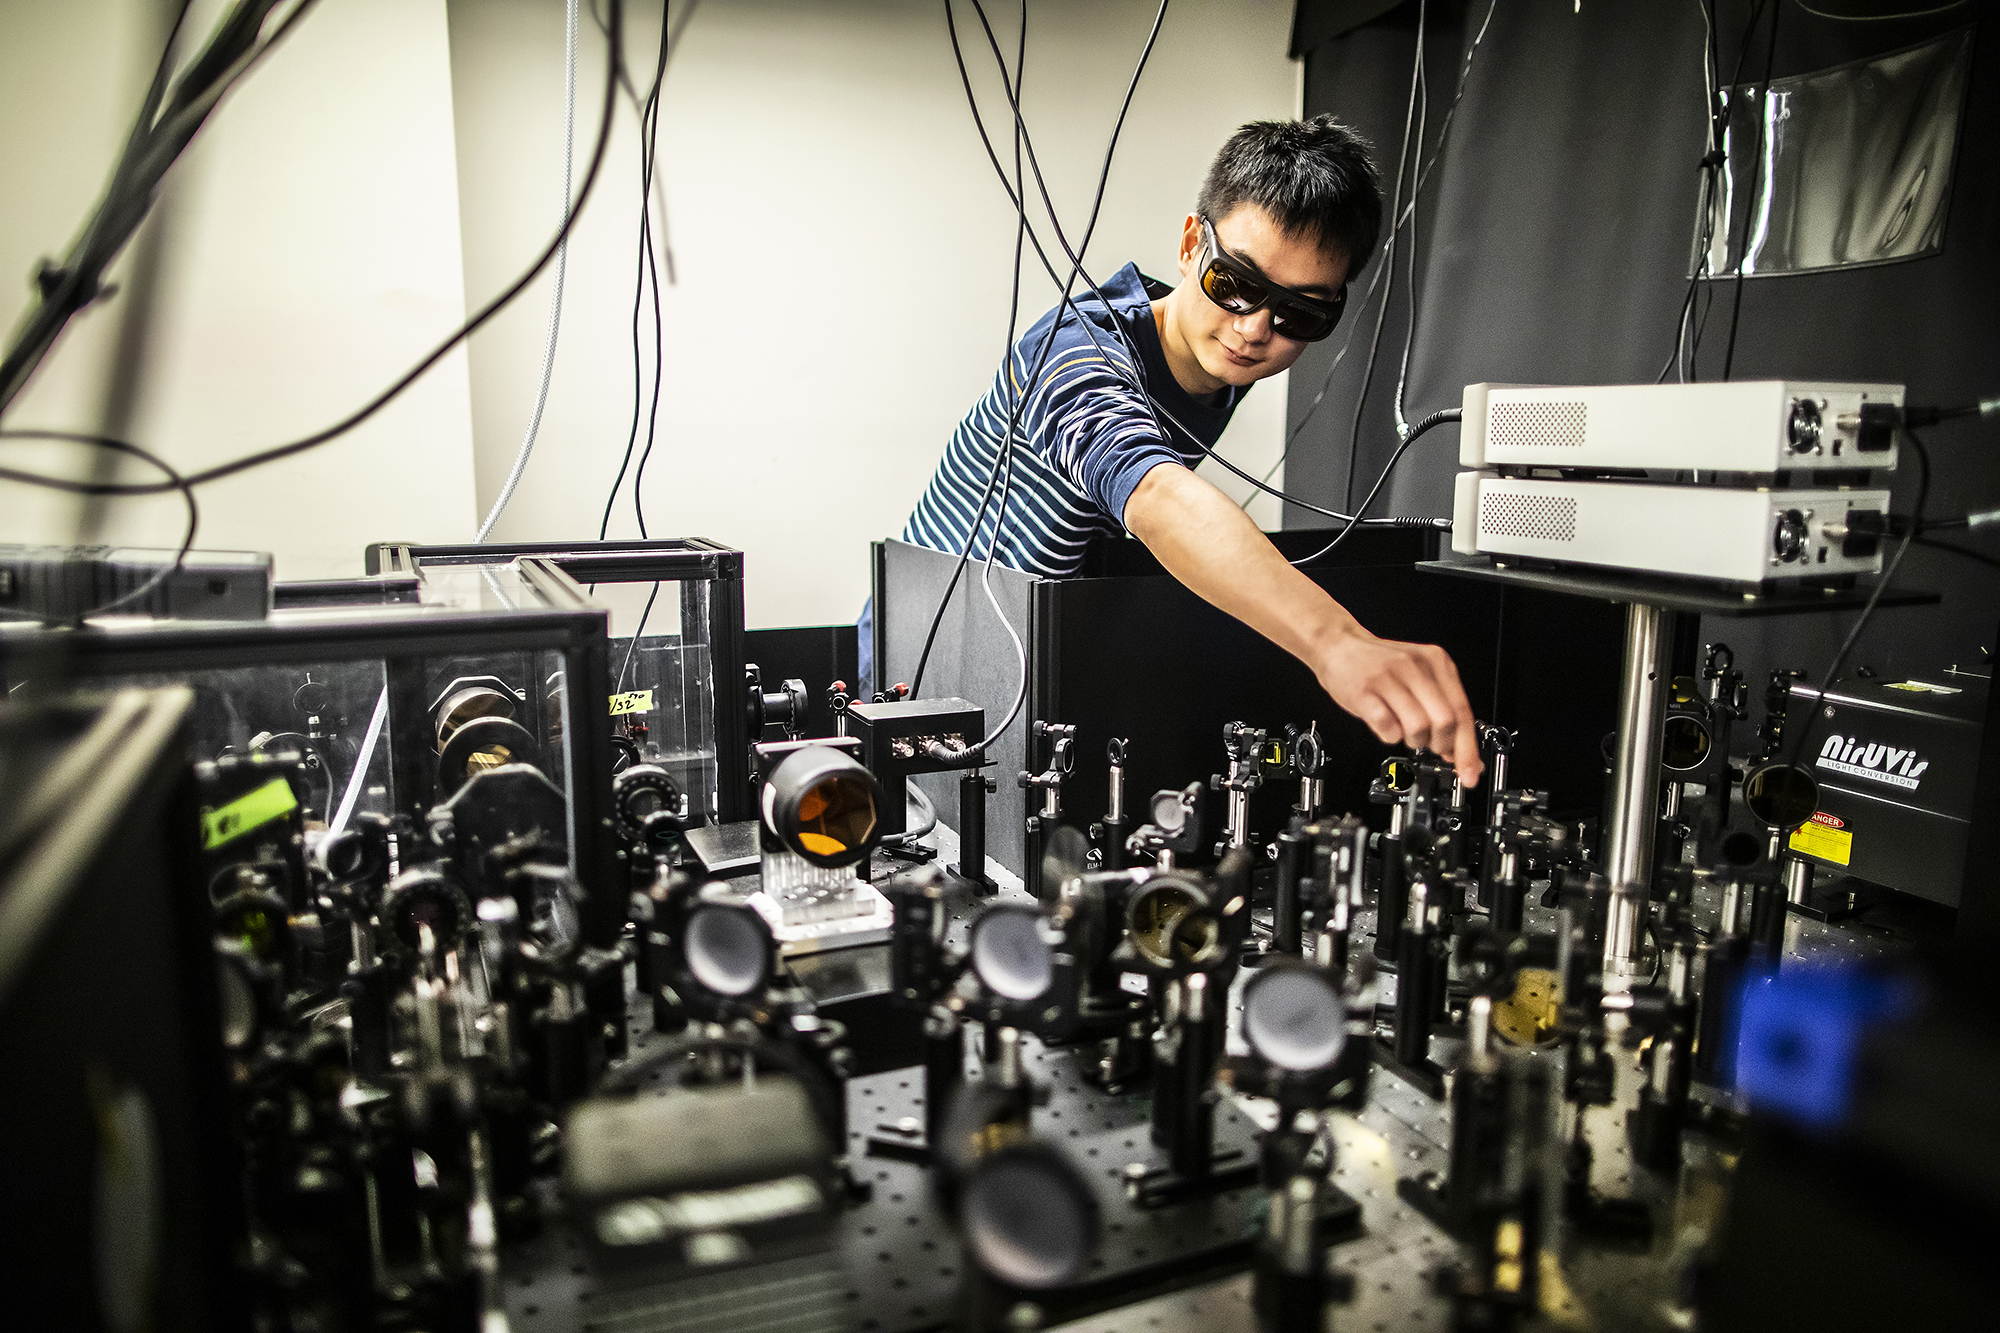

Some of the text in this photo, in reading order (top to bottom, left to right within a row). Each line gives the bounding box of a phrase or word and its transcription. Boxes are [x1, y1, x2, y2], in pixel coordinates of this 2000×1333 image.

[1827, 761, 1913, 787] LIGHT CONVERSION
[1811, 814, 1839, 827] ANGER
